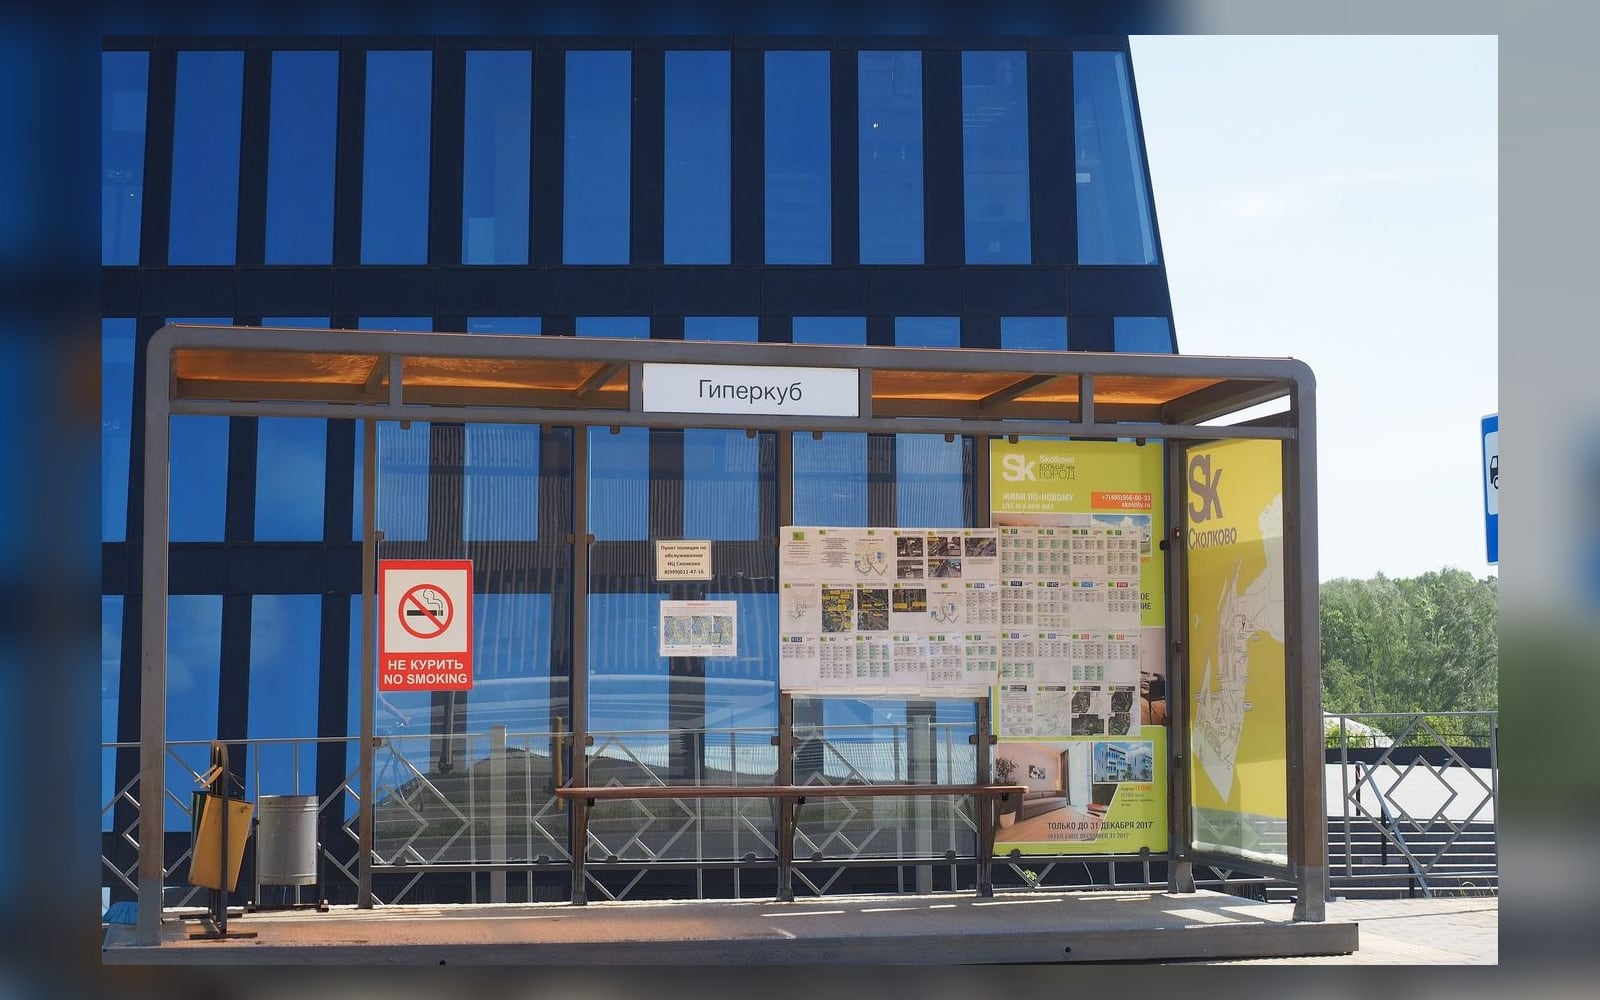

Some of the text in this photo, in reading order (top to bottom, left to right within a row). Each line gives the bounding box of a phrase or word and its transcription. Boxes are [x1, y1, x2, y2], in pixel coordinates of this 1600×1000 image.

[699, 379, 802, 405] Гиперкуб
[1002, 453, 1038, 481] Sk
[1039, 469, 1076, 480] ГОРОД
[1188, 454, 1223, 523] Sk
[1188, 527, 1237, 550] Сколково
[388, 659, 464, 671] НЕ КУРИТЬ
[384, 673, 468, 685] NO SMOKING
[1047, 822, 1076, 830] ТОЛЬКО
[1078, 822, 1089, 831] ДО
[1090, 822, 1098, 830] 31
[1101, 821, 1135, 831] ДЕКАБРЯ
